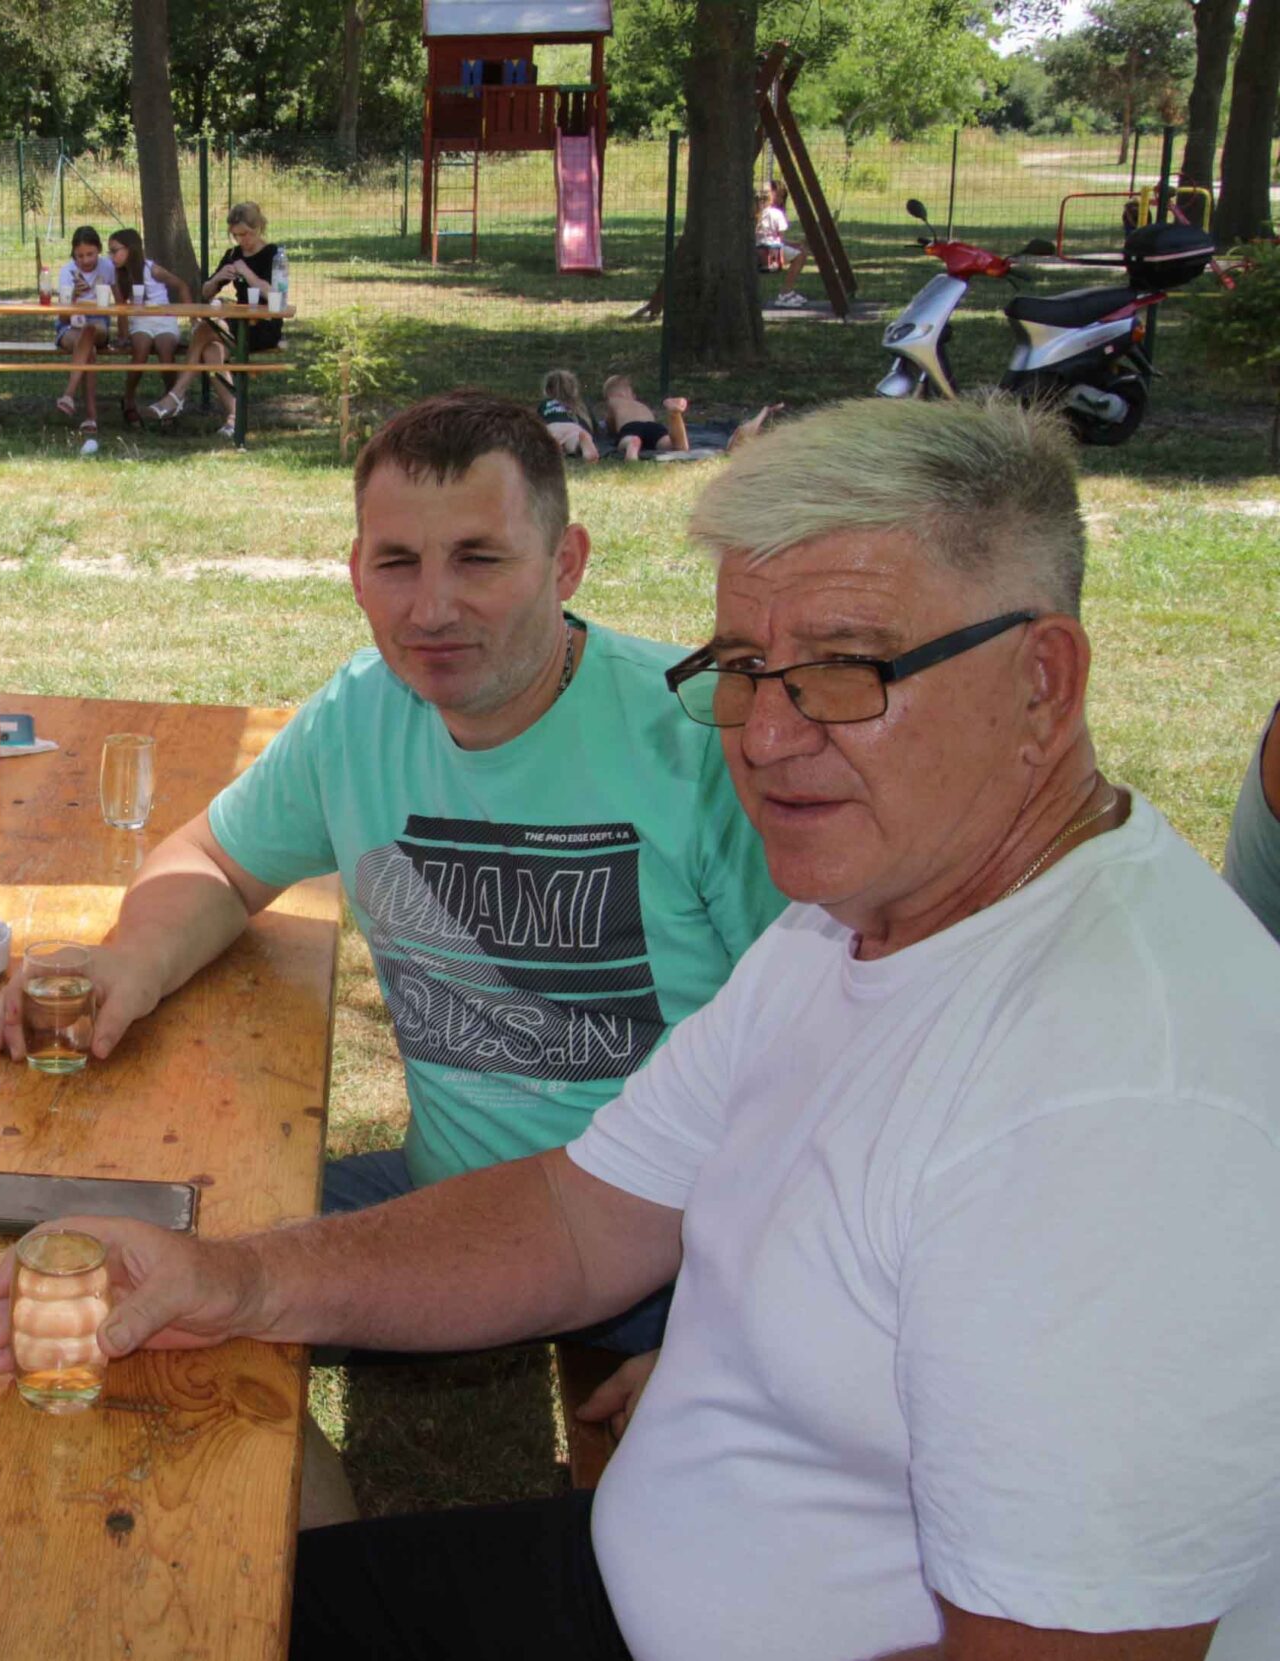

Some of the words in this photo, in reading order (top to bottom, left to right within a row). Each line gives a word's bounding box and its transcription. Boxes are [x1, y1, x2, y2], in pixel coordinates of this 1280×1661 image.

[524, 832, 545, 841] THE
[546, 833, 567, 843] PRO
[568, 832, 589, 843] EDGE
[590, 831, 615, 841] DEPT.
[371, 854, 612, 949] MIAMI
